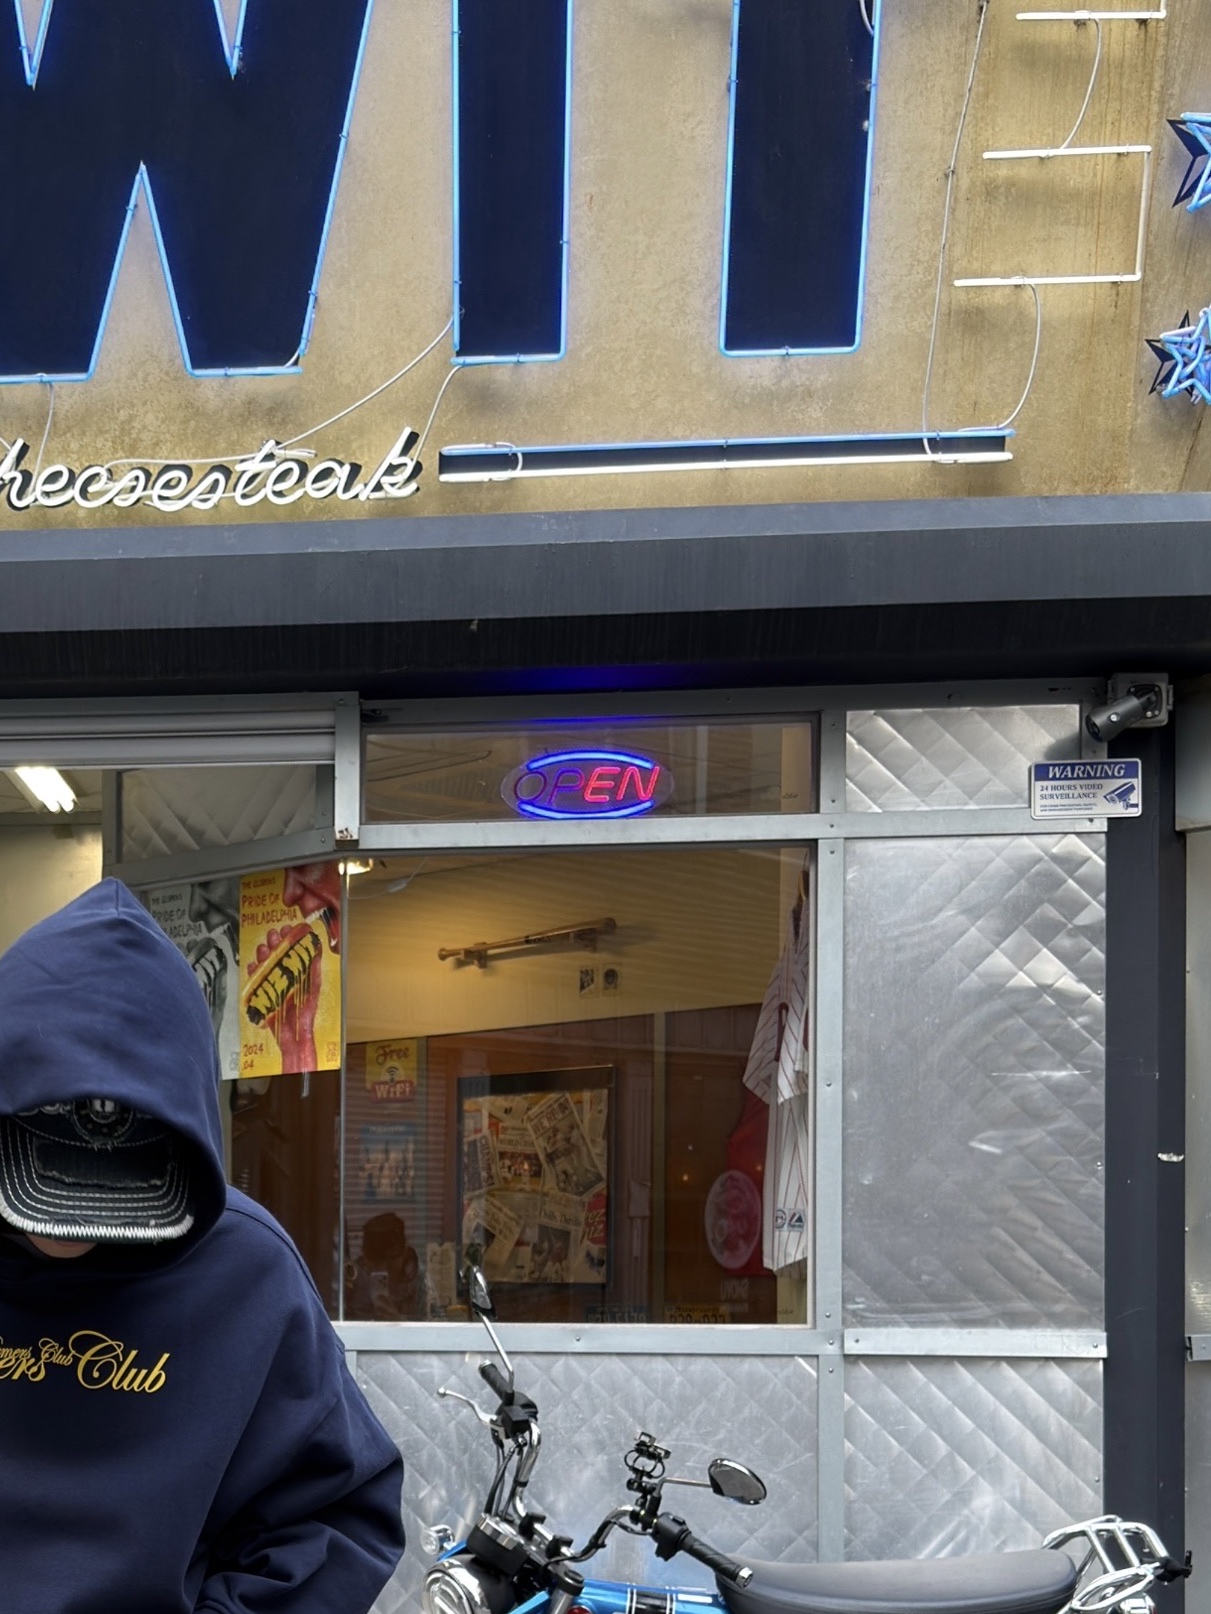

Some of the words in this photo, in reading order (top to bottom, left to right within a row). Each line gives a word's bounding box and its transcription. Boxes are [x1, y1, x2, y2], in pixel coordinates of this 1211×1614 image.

[1047, 764, 1126, 778] WARNING
[514, 766, 661, 804] OPEN
[1079, 782, 1104, 790] VIDEO
[1039, 791, 1097, 800] SURVEILLANCE
[241, 894, 267, 909] PRIDE
[268, 892, 280, 905] OF
[241, 908, 298, 927] PHILADELPHIA
[242, 1043, 265, 1058] 2024
[375, 1045, 410, 1066] Free
[39, 1338, 73, 1366] Club
[69, 1330, 170, 1393] Club
